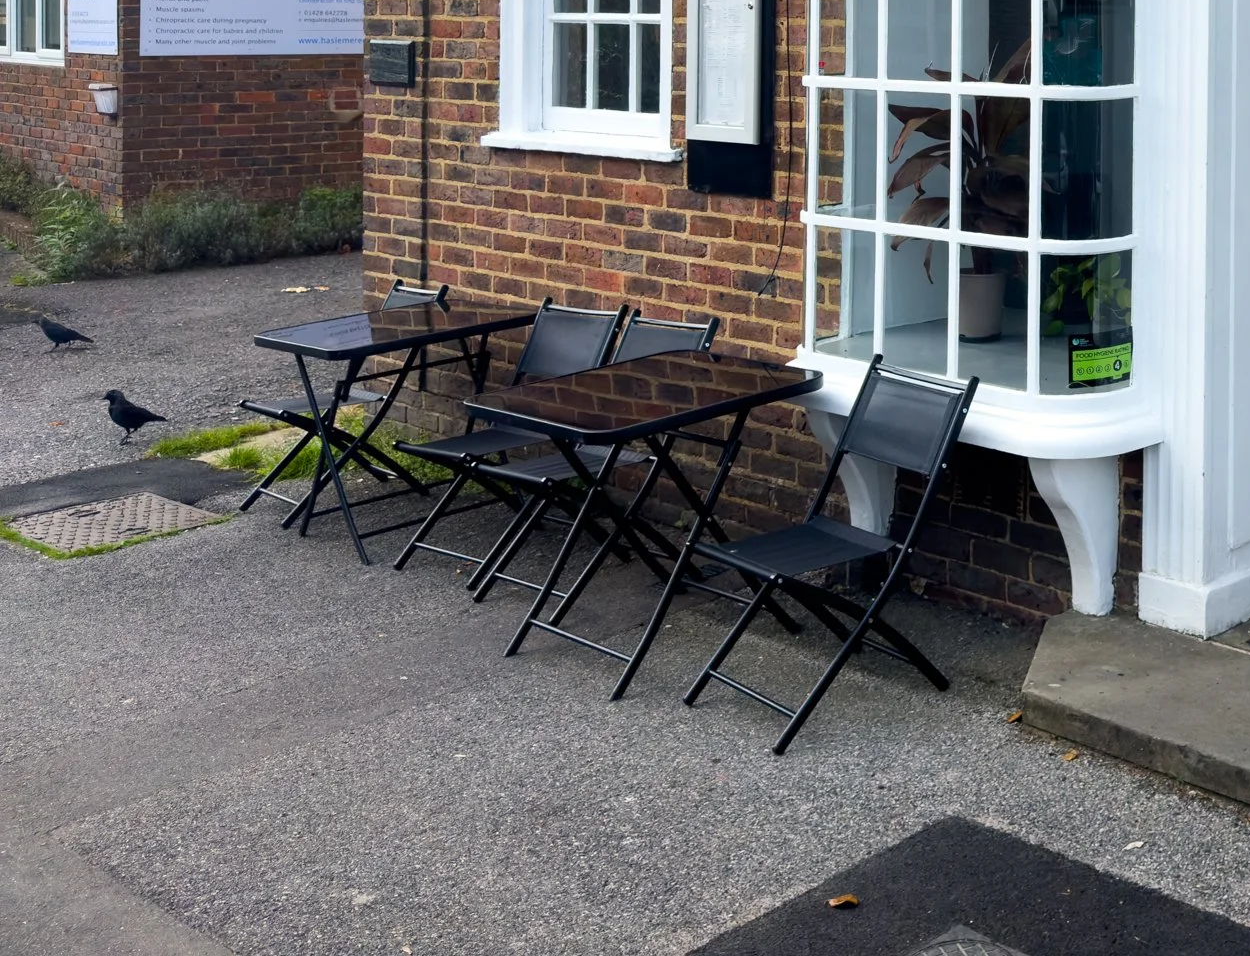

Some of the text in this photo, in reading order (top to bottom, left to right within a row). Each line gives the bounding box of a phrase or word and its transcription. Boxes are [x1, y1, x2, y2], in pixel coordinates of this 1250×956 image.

[155, 17, 195, 25] Chiropractic
[212, 17, 233, 25] during
[234, 18, 267, 26] pregnancy
[155, 27, 195, 35] Chiropractic
[155, 38, 173, 46] Many
[1093, 349, 1114, 358] HYGIENE
